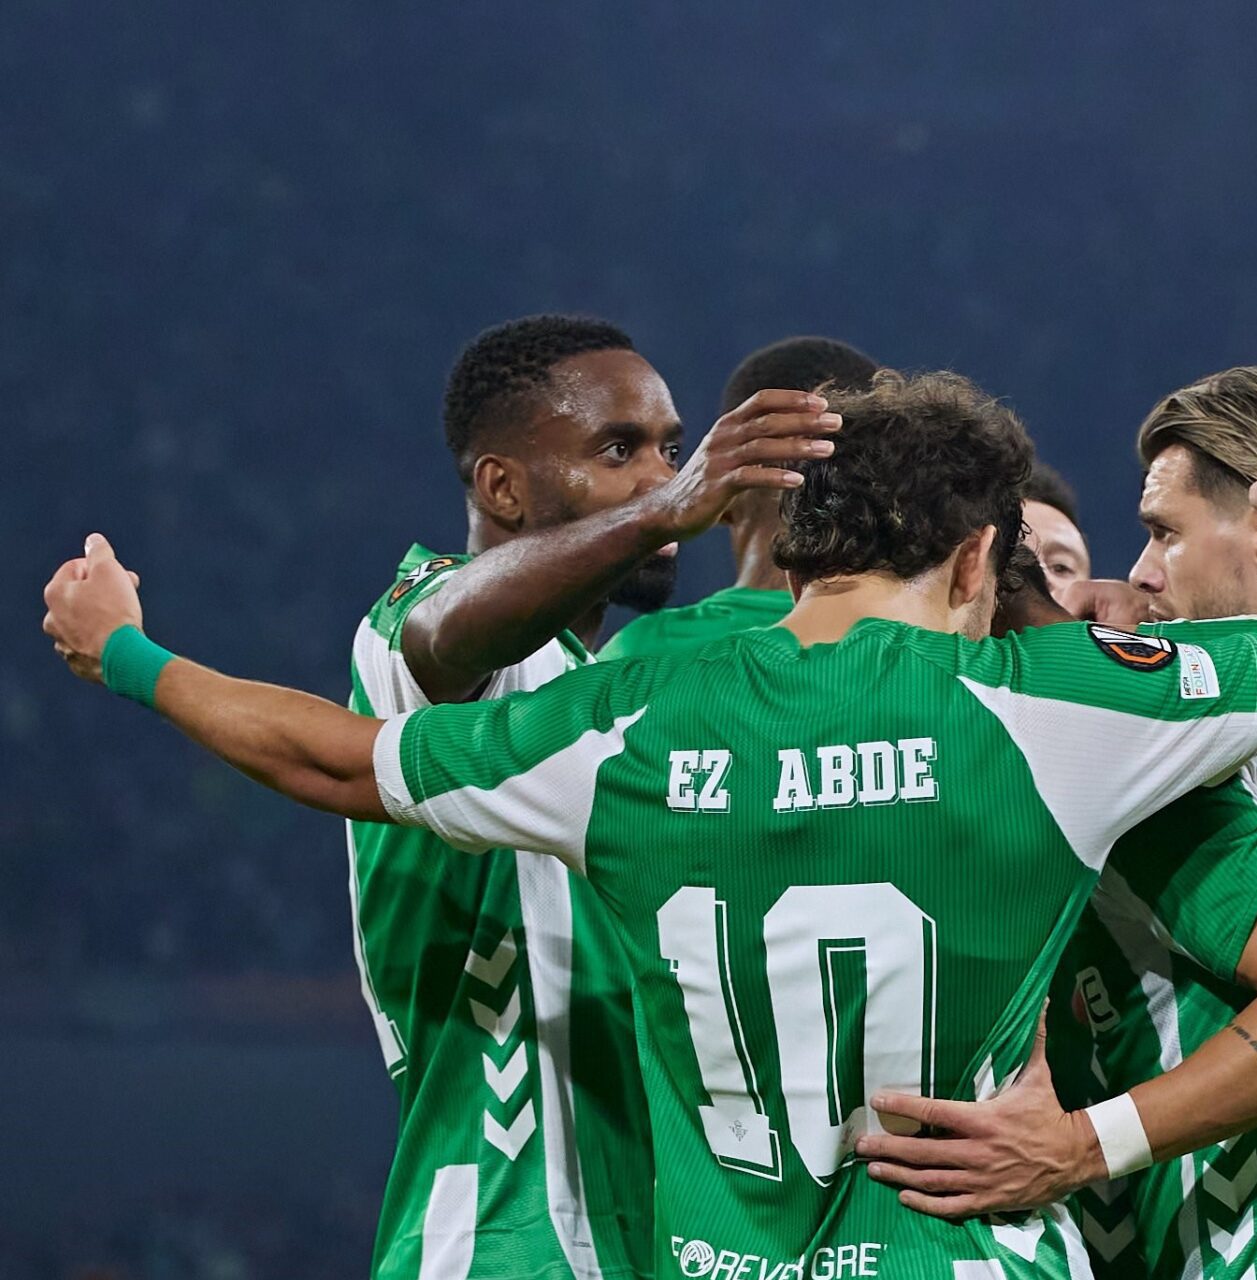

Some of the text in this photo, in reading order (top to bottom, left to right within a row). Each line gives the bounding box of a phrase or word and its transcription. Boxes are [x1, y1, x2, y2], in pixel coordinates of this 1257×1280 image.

[666, 737, 939, 813] EZ ABDE
[656, 881, 937, 1187] 10
